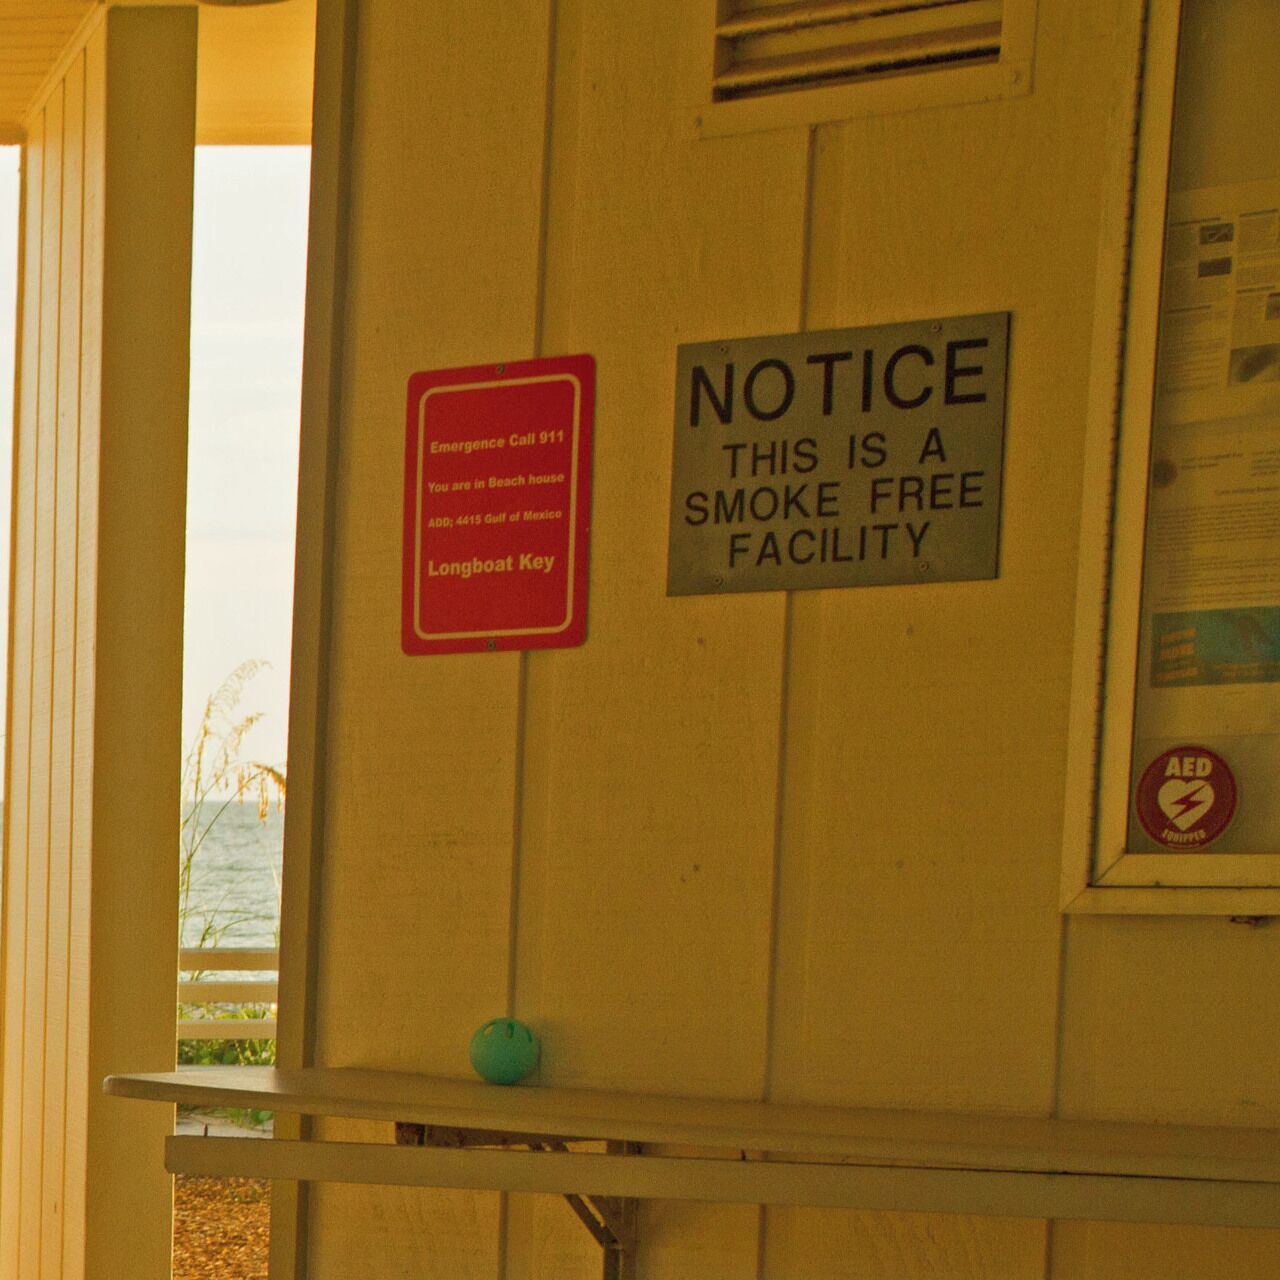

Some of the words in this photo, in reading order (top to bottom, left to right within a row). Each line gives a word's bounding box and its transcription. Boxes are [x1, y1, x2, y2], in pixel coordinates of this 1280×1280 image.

[690, 338, 988, 427] NOTICE
[430, 438, 505, 454] Emergence
[510, 433, 536, 447] Call
[540, 430, 564, 443] 911
[722, 438, 818, 478] THIS
[848, 432, 886, 469] IS
[918, 428, 946, 464] A
[429, 482, 448, 493] You
[452, 482, 471, 491] are
[475, 479, 484, 489] in
[489, 475, 525, 488] Beach
[529, 473, 564, 484] house
[685, 482, 840, 526] SMOKE
[871, 471, 984, 514] FREE
[456, 515, 481, 525] 4415
[485, 513, 506, 524] Gulf
[509, 512, 520, 522] of
[524, 509, 562, 521] Mexico
[729, 522, 930, 568] FACILITY
[428, 555, 513, 578] Longboat
[520, 554, 554, 573] Key
[1165, 757, 1213, 777] AED
